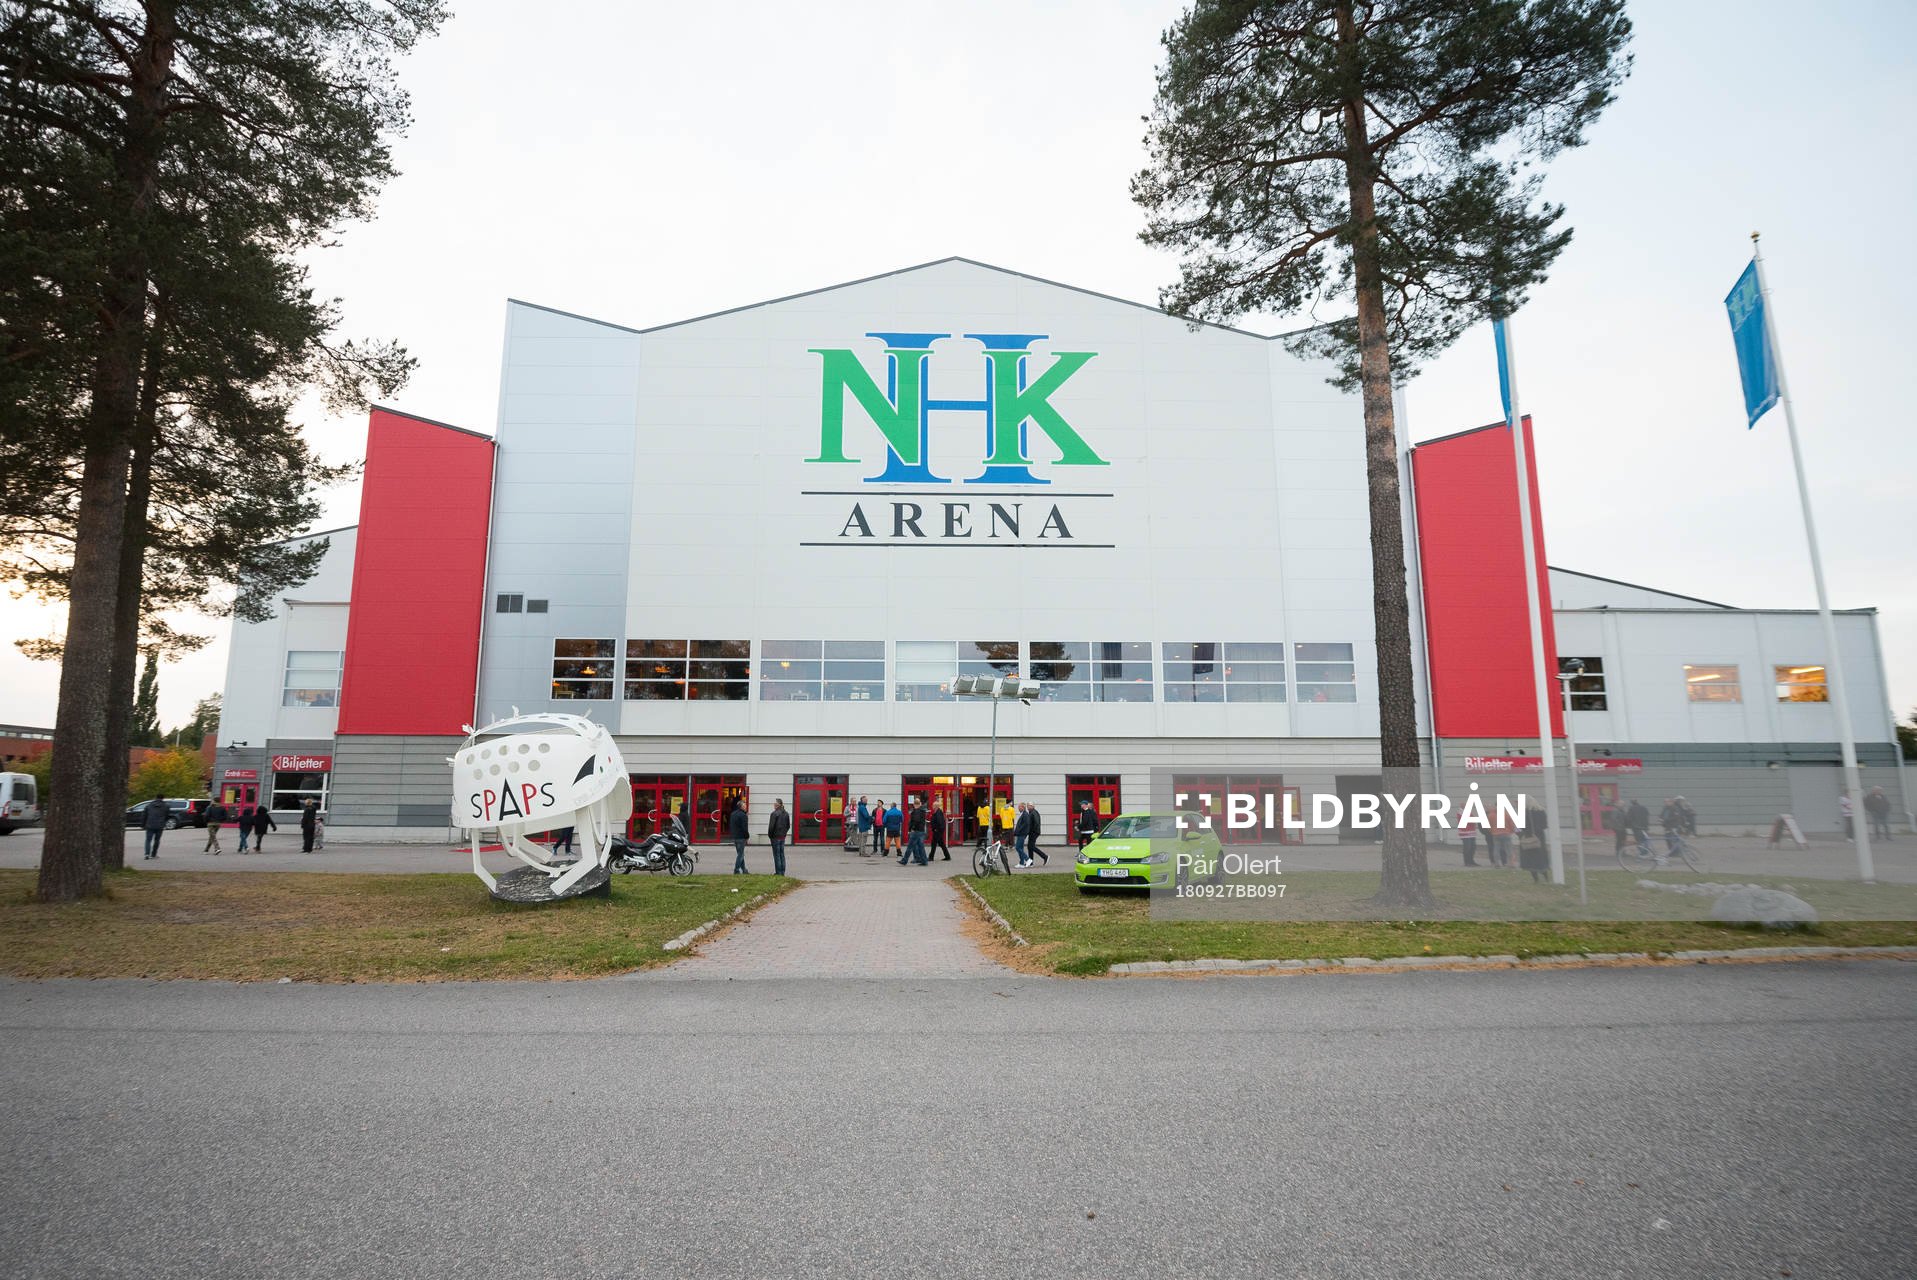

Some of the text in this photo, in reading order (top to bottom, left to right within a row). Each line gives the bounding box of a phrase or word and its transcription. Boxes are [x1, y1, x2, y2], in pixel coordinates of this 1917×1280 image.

[803, 333, 1111, 484] NHK
[837, 501, 1074, 539] ARENA
[282, 755, 325, 771] Biljetter
[1465, 757, 1514, 773] Biljetter
[470, 777, 555, 822] SPAPS
